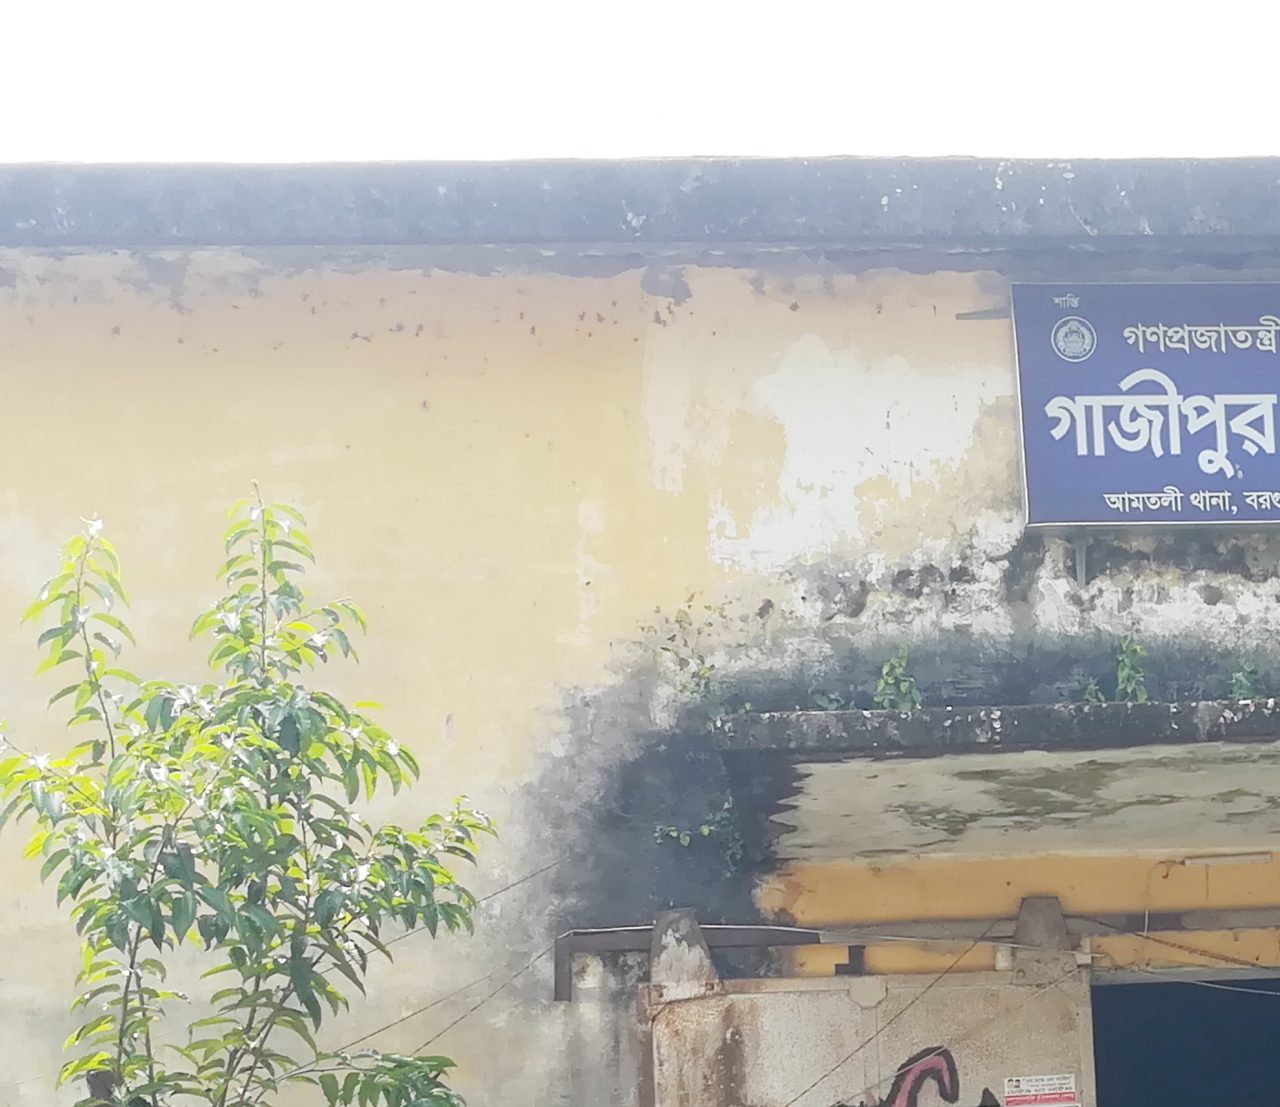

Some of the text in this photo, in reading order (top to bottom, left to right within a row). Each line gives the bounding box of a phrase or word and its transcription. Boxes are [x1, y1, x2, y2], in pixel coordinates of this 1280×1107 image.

[1044, 368, 1278, 479] গাজীপুর
[1102, 485, 1185, 513] আমতলী
[1189, 489, 1238, 515] থানা,
